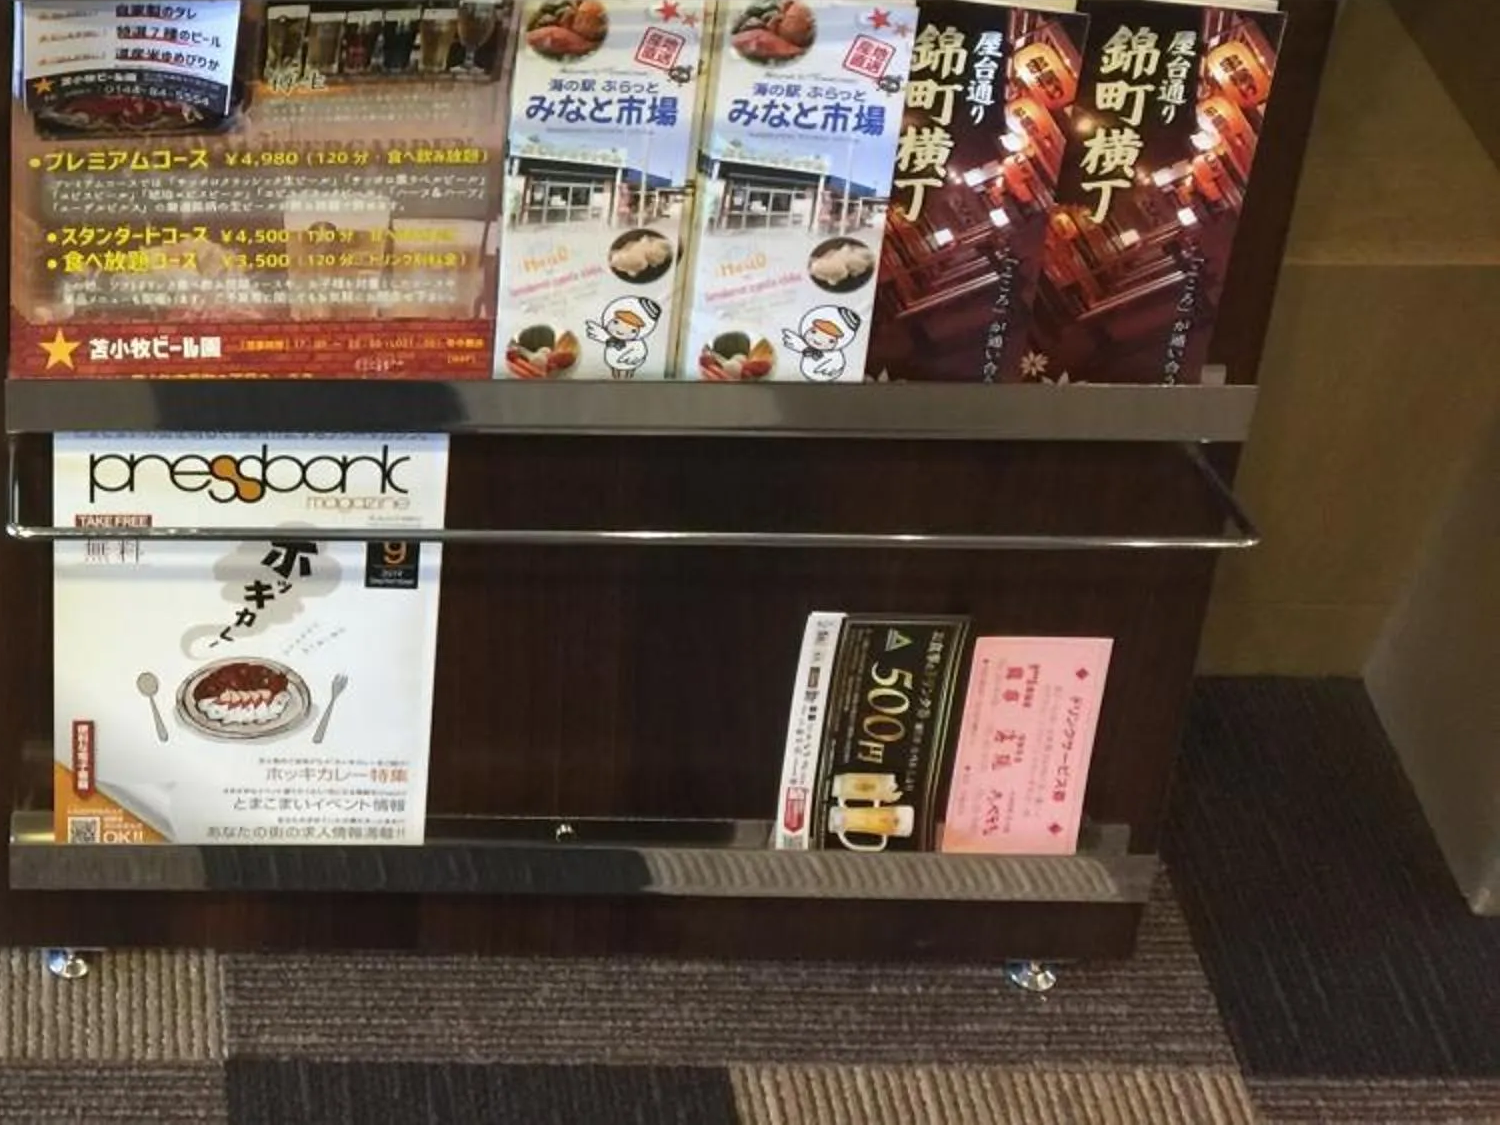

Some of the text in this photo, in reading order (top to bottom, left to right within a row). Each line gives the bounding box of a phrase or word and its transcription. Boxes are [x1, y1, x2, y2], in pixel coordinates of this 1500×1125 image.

[116, 5, 196, 20] 自家製のタレ
[549, 79, 595, 92] 海の駅
[966, 30, 1004, 125] 屋台通り
[1158, 30, 1197, 125] 屋台通り
[753, 83, 800, 97] 海の駅
[525, 95, 678, 126] みなと市場
[728, 98, 886, 135] みなと市場
[894, 23, 969, 222] 錦町横丁
[1080, 24, 1160, 224] 錦町横丁
[44, 149, 209, 172] プレミアムコース
[62, 250, 197, 272] 食べ放題コース
[90, 336, 221, 359] 苫小牧ビール園
[89, 444, 411, 503] pressbank
[306, 496, 409, 513] magazine
[79, 516, 149, 527] TAKE FREE
[383, 540, 407, 564] 9
[859, 661, 913, 764] 500円
[266, 768, 408, 783] ホッキカレー特集
[233, 797, 405, 812] とまこまいイベント情報
[104, 831, 143, 843] OK!!
